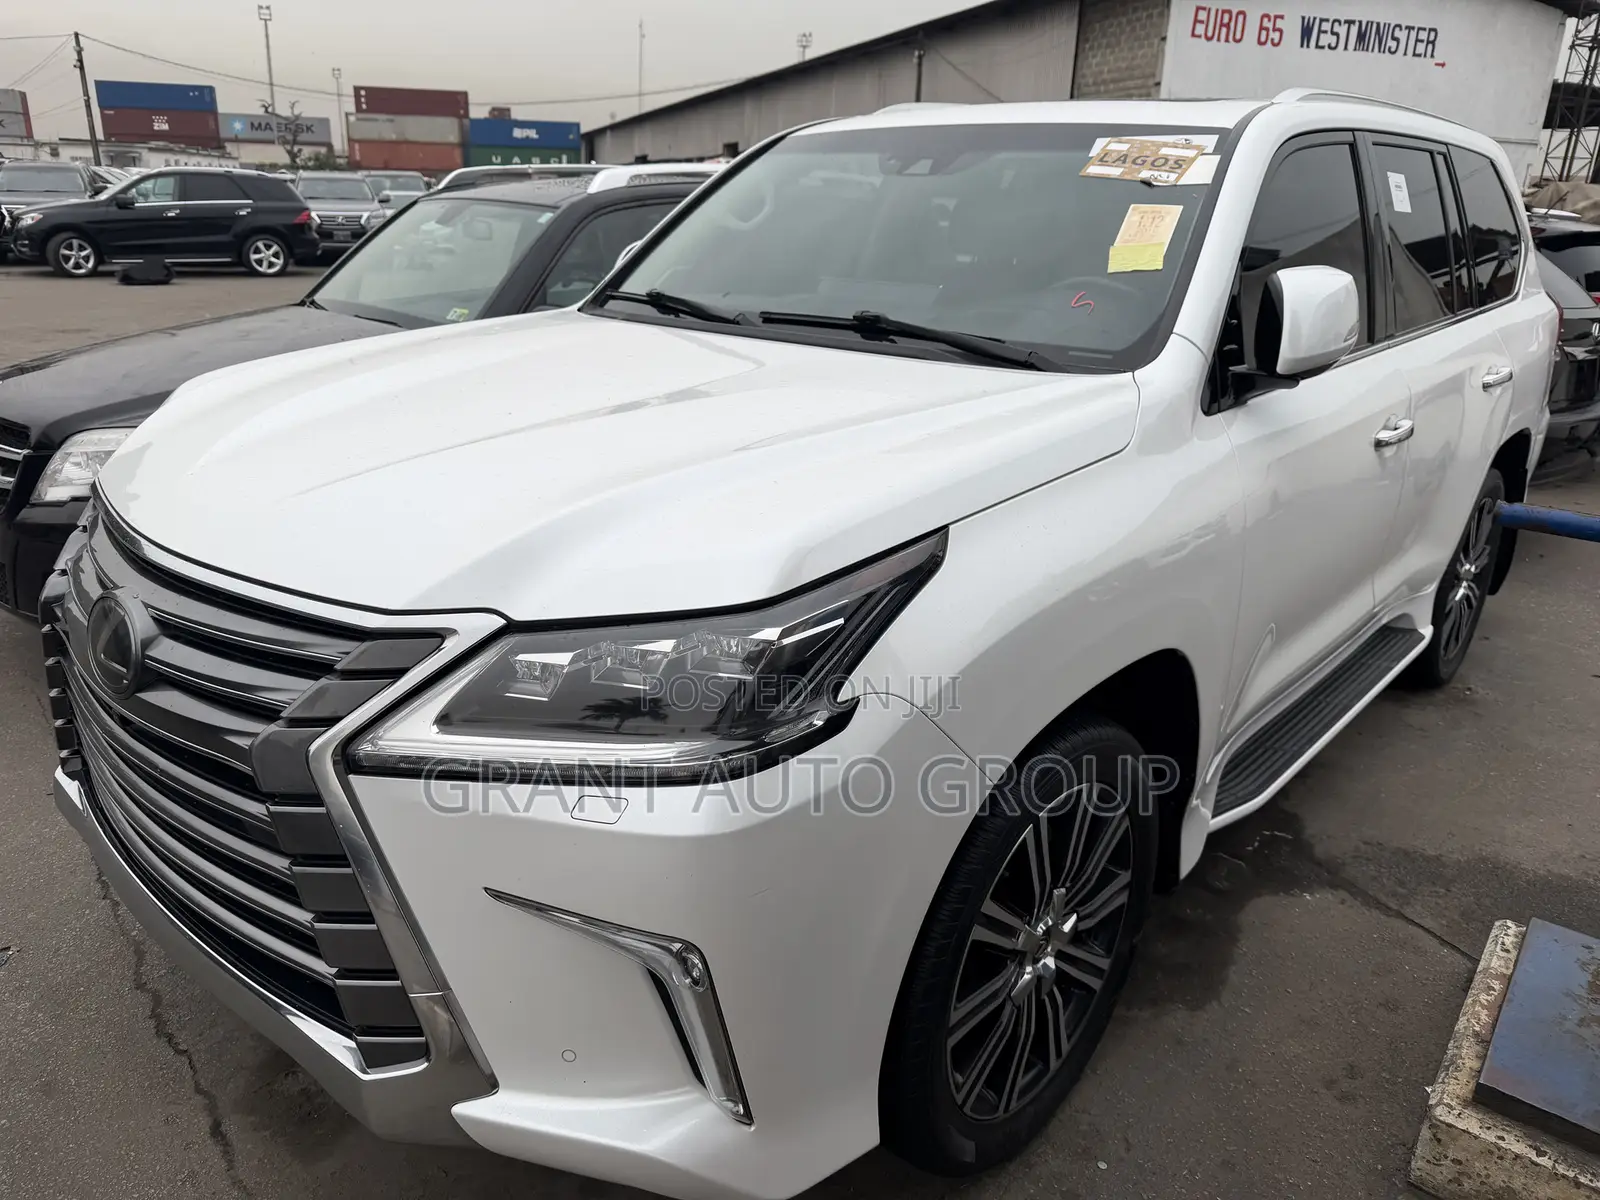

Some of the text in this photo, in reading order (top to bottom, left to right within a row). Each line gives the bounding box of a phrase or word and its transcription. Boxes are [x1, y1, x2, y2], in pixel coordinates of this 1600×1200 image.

[1191, 5, 1438, 59] EURO 65 WESTMINISTER
[153, 122, 169, 130] ZIM
[1097, 152, 1187, 170] LAGOS
